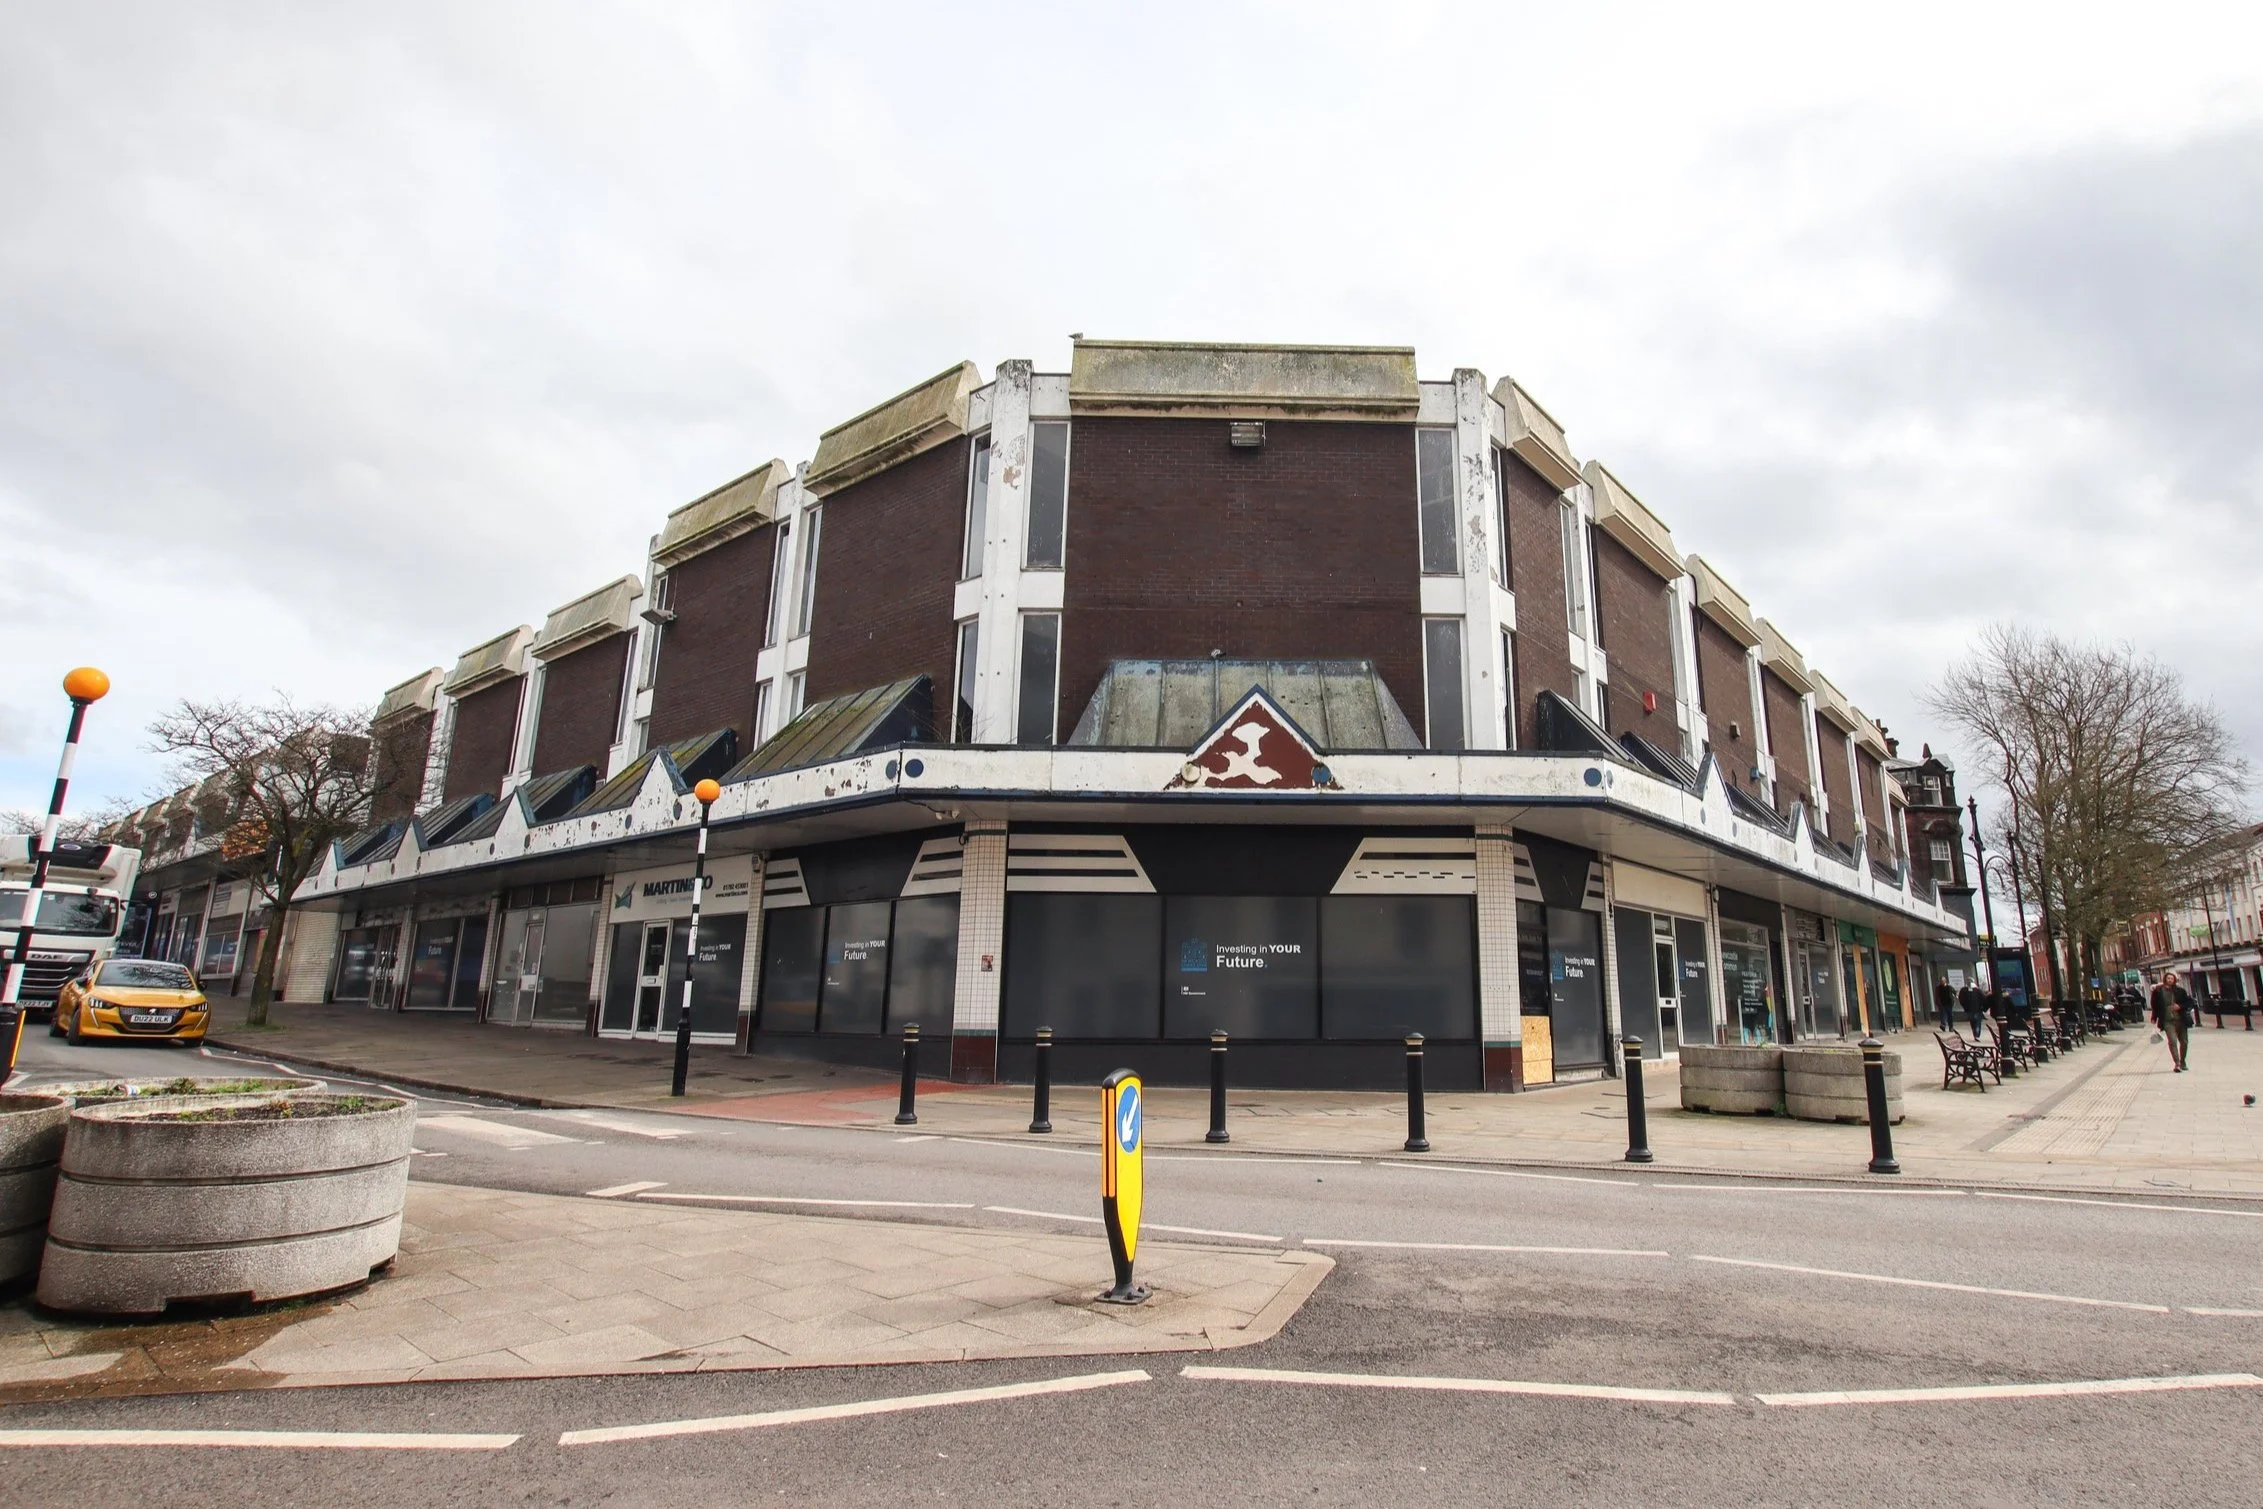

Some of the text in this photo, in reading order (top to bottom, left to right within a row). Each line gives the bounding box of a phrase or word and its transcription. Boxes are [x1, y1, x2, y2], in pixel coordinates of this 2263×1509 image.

[1216, 944, 1301, 955] Investing in YOUR
[699, 953, 717, 961] Future
[844, 950, 867, 960] Future
